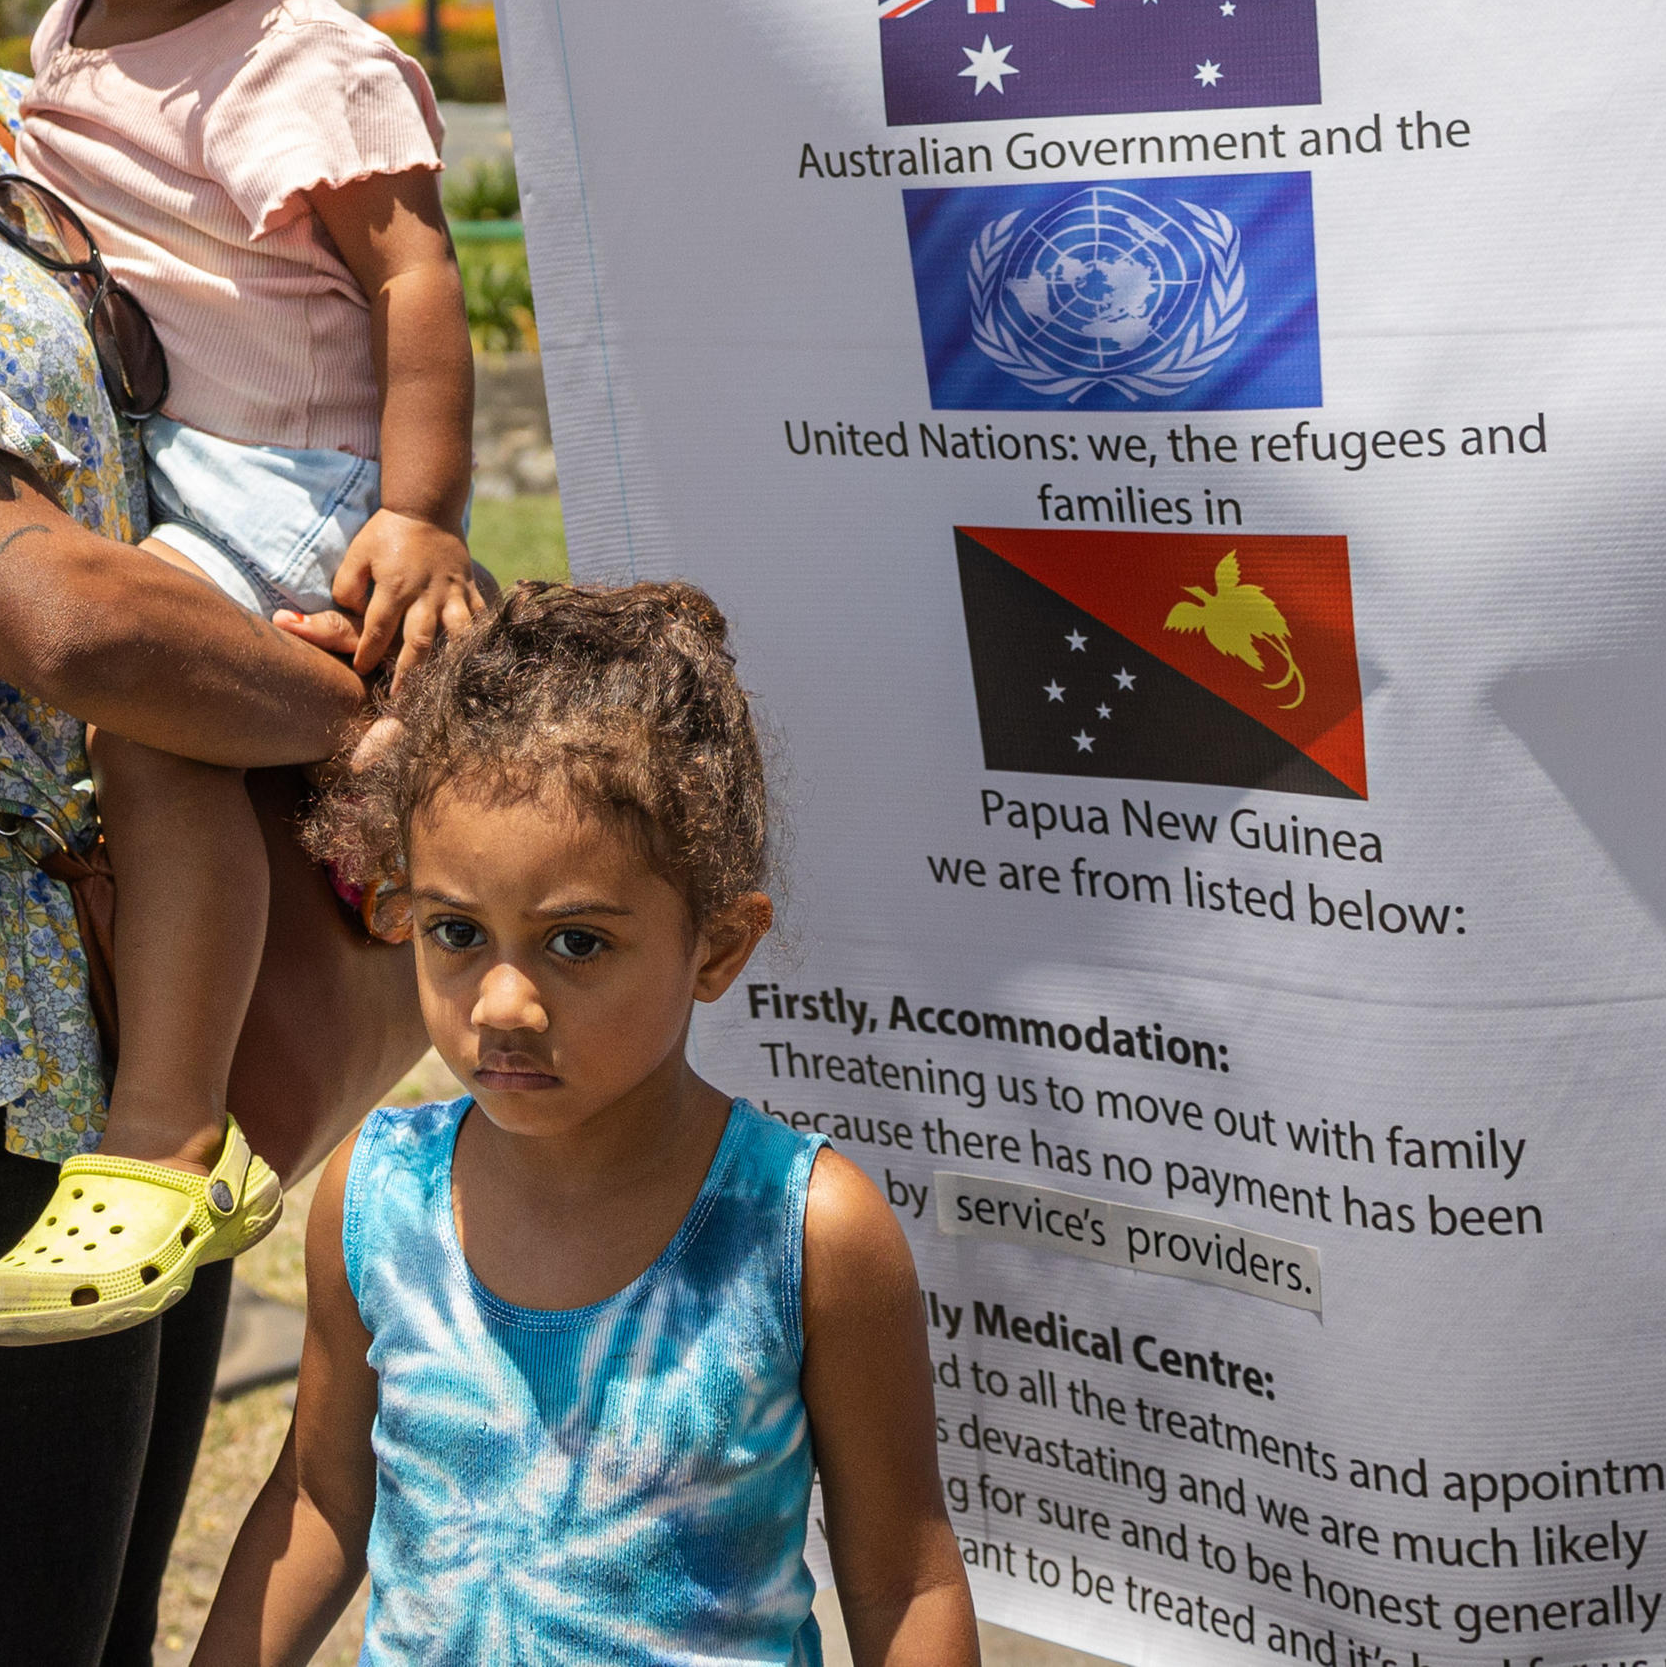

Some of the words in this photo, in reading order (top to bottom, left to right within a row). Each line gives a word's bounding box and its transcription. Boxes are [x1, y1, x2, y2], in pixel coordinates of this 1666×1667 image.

[798, 136, 993, 179] Australian
[1005, 123, 1287, 171] Government
[1299, 113, 1382, 157] and
[1396, 110, 1471, 151] the
[784, 420, 910, 458] United
[918, 422, 1079, 462] Nations:
[1086, 434, 1157, 469] we,
[1166, 423, 1238, 463] the
[1251, 420, 1446, 472] refugees
[1460, 412, 1547, 456] and
[1037, 482, 1193, 526] families
[1203, 488, 1243, 526] in
[980, 789, 1110, 841] Papua
[1121, 798, 1218, 844] New
[1230, 808, 1383, 864] Guinea
[926, 855, 987, 888] we
[998, 861, 1061, 895] are
[1070, 856, 1172, 905] from
[1183, 866, 1295, 922] listed
[1308, 882, 1466, 935] below:
[746, 983, 878, 1037] Firstly,
[888, 995, 1230, 1074] Accommodation:
[759, 1041, 987, 1109] Threatening
[996, 1074, 1039, 1107] us
[1044, 1076, 1085, 1115] to
[1096, 1089, 1204, 1132] move
[1213, 1107, 1278, 1147] out
[1286, 1117, 1375, 1164] with
[1385, 1124, 1527, 1181] family
[884, 1168, 929, 1220] by
[955, 1194, 1107, 1248] service's
[1126, 1225, 1312, 1295] providers.
[921, 1117, 1021, 1164] there
[1030, 1128, 1092, 1177] has
[1102, 1152, 1153, 1186] no
[1164, 1161, 1333, 1223] payment
[1342, 1184, 1416, 1234] has
[1428, 1193, 1543, 1237] been
[972, 1299, 1124, 1365] Medical
[1132, 1334, 1276, 1402] Centre:
[969, 1360, 1009, 1398] to
[1019, 1368, 1058, 1409] all
[1067, 1378, 1127, 1427] the
[1134, 1397, 1338, 1482] treatments
[1349, 1457, 1429, 1499] and
[957, 1413, 1167, 1505] devastating
[1178, 1473, 1247, 1518] and
[1256, 1494, 1310, 1537] we
[1320, 1514, 1380, 1556] are
[1392, 1526, 1519, 1569] much
[1532, 1519, 1649, 1571] likely
[955, 1535, 1017, 1578] ant
[1025, 1547, 1061, 1588] to
[1071, 1554, 1115, 1605] be
[1124, 1575, 1255, 1645] treated
[1267, 1622, 1338, 1667] and
[1347, 1636, 1398, 1667] it'
[977, 1472, 1027, 1518] for
[1037, 1497, 1111, 1541] sure
[1121, 1519, 1189, 1563] and
[1197, 1533, 1237, 1575] to
[1245, 1541, 1293, 1593] be
[1302, 1558, 1442, 1631] honest
[1453, 1583, 1663, 1645] generally
